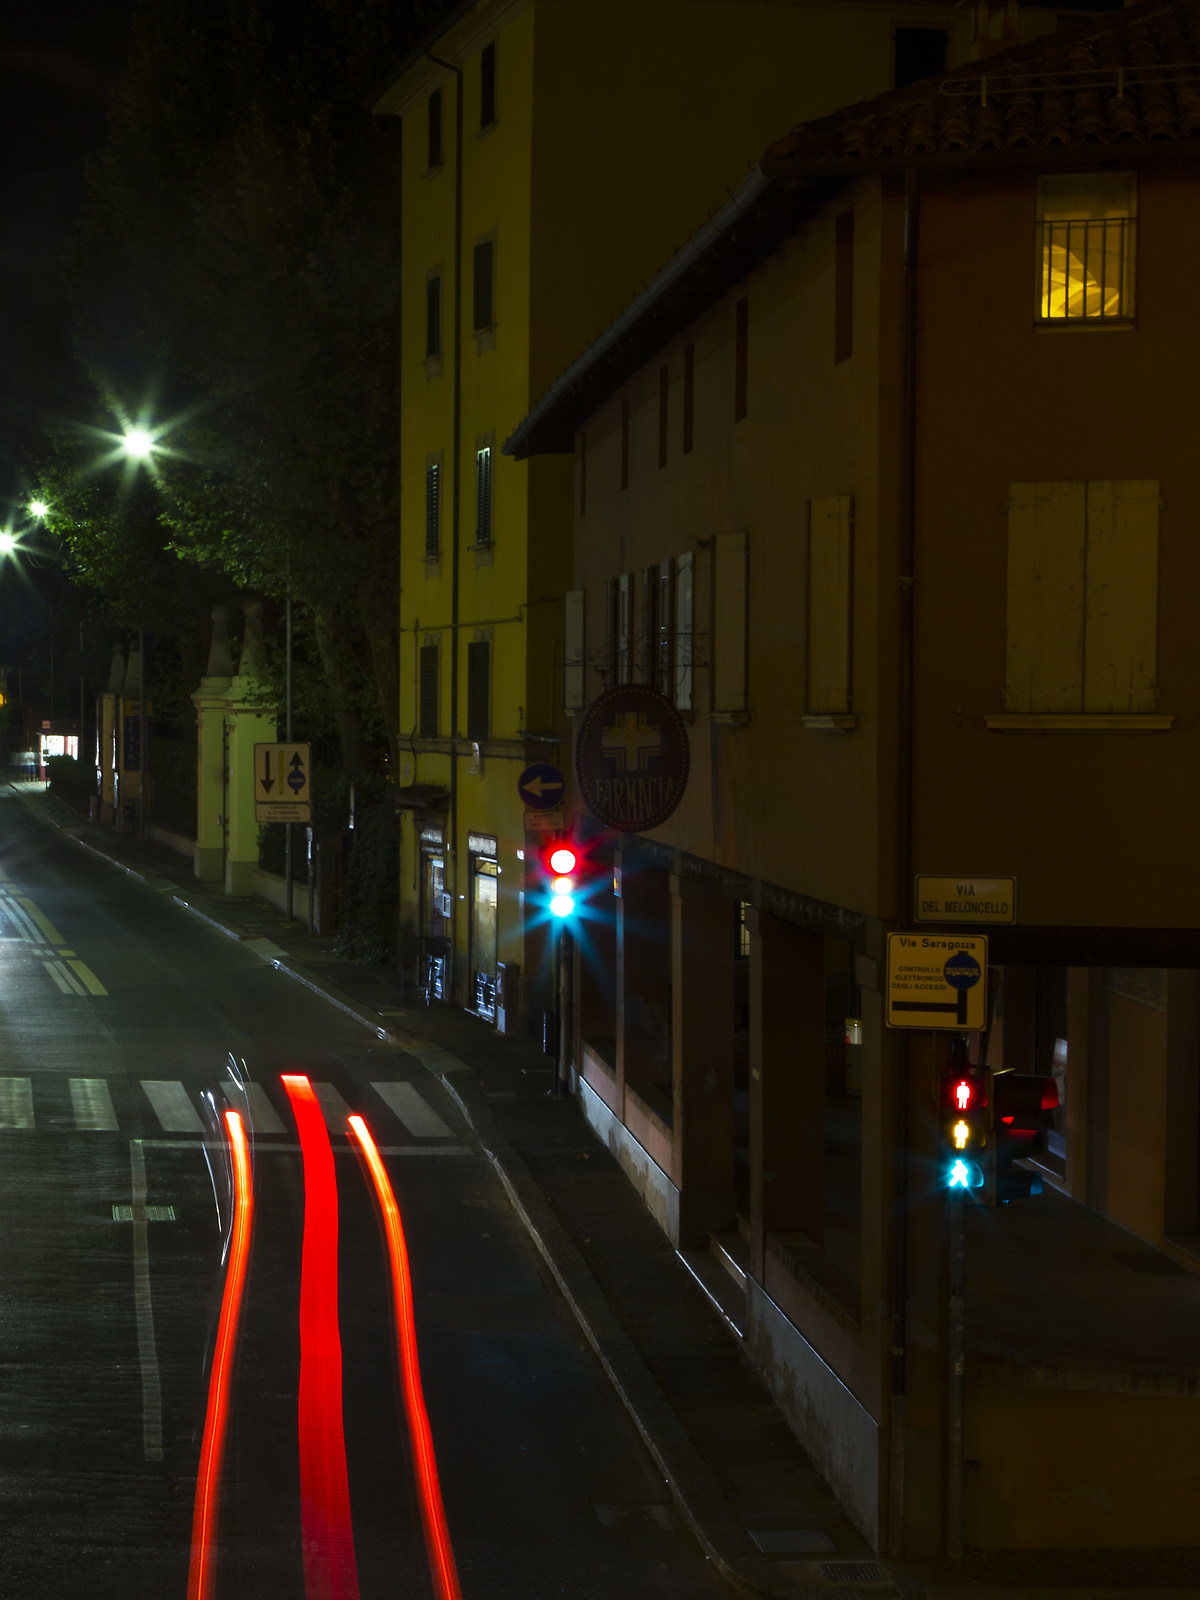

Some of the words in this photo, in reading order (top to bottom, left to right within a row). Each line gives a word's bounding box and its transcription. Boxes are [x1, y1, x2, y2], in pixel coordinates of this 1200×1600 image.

[594, 776, 674, 822] FARMACIA
[956, 884, 976, 897] VIA
[921, 901, 941, 913] DEL
[944, 901, 1009, 914] MELONCELLO
[899, 937, 918, 948] Via
[921, 938, 976, 950] Saragozza
[895, 974, 944, 982] ELETTRONICO
